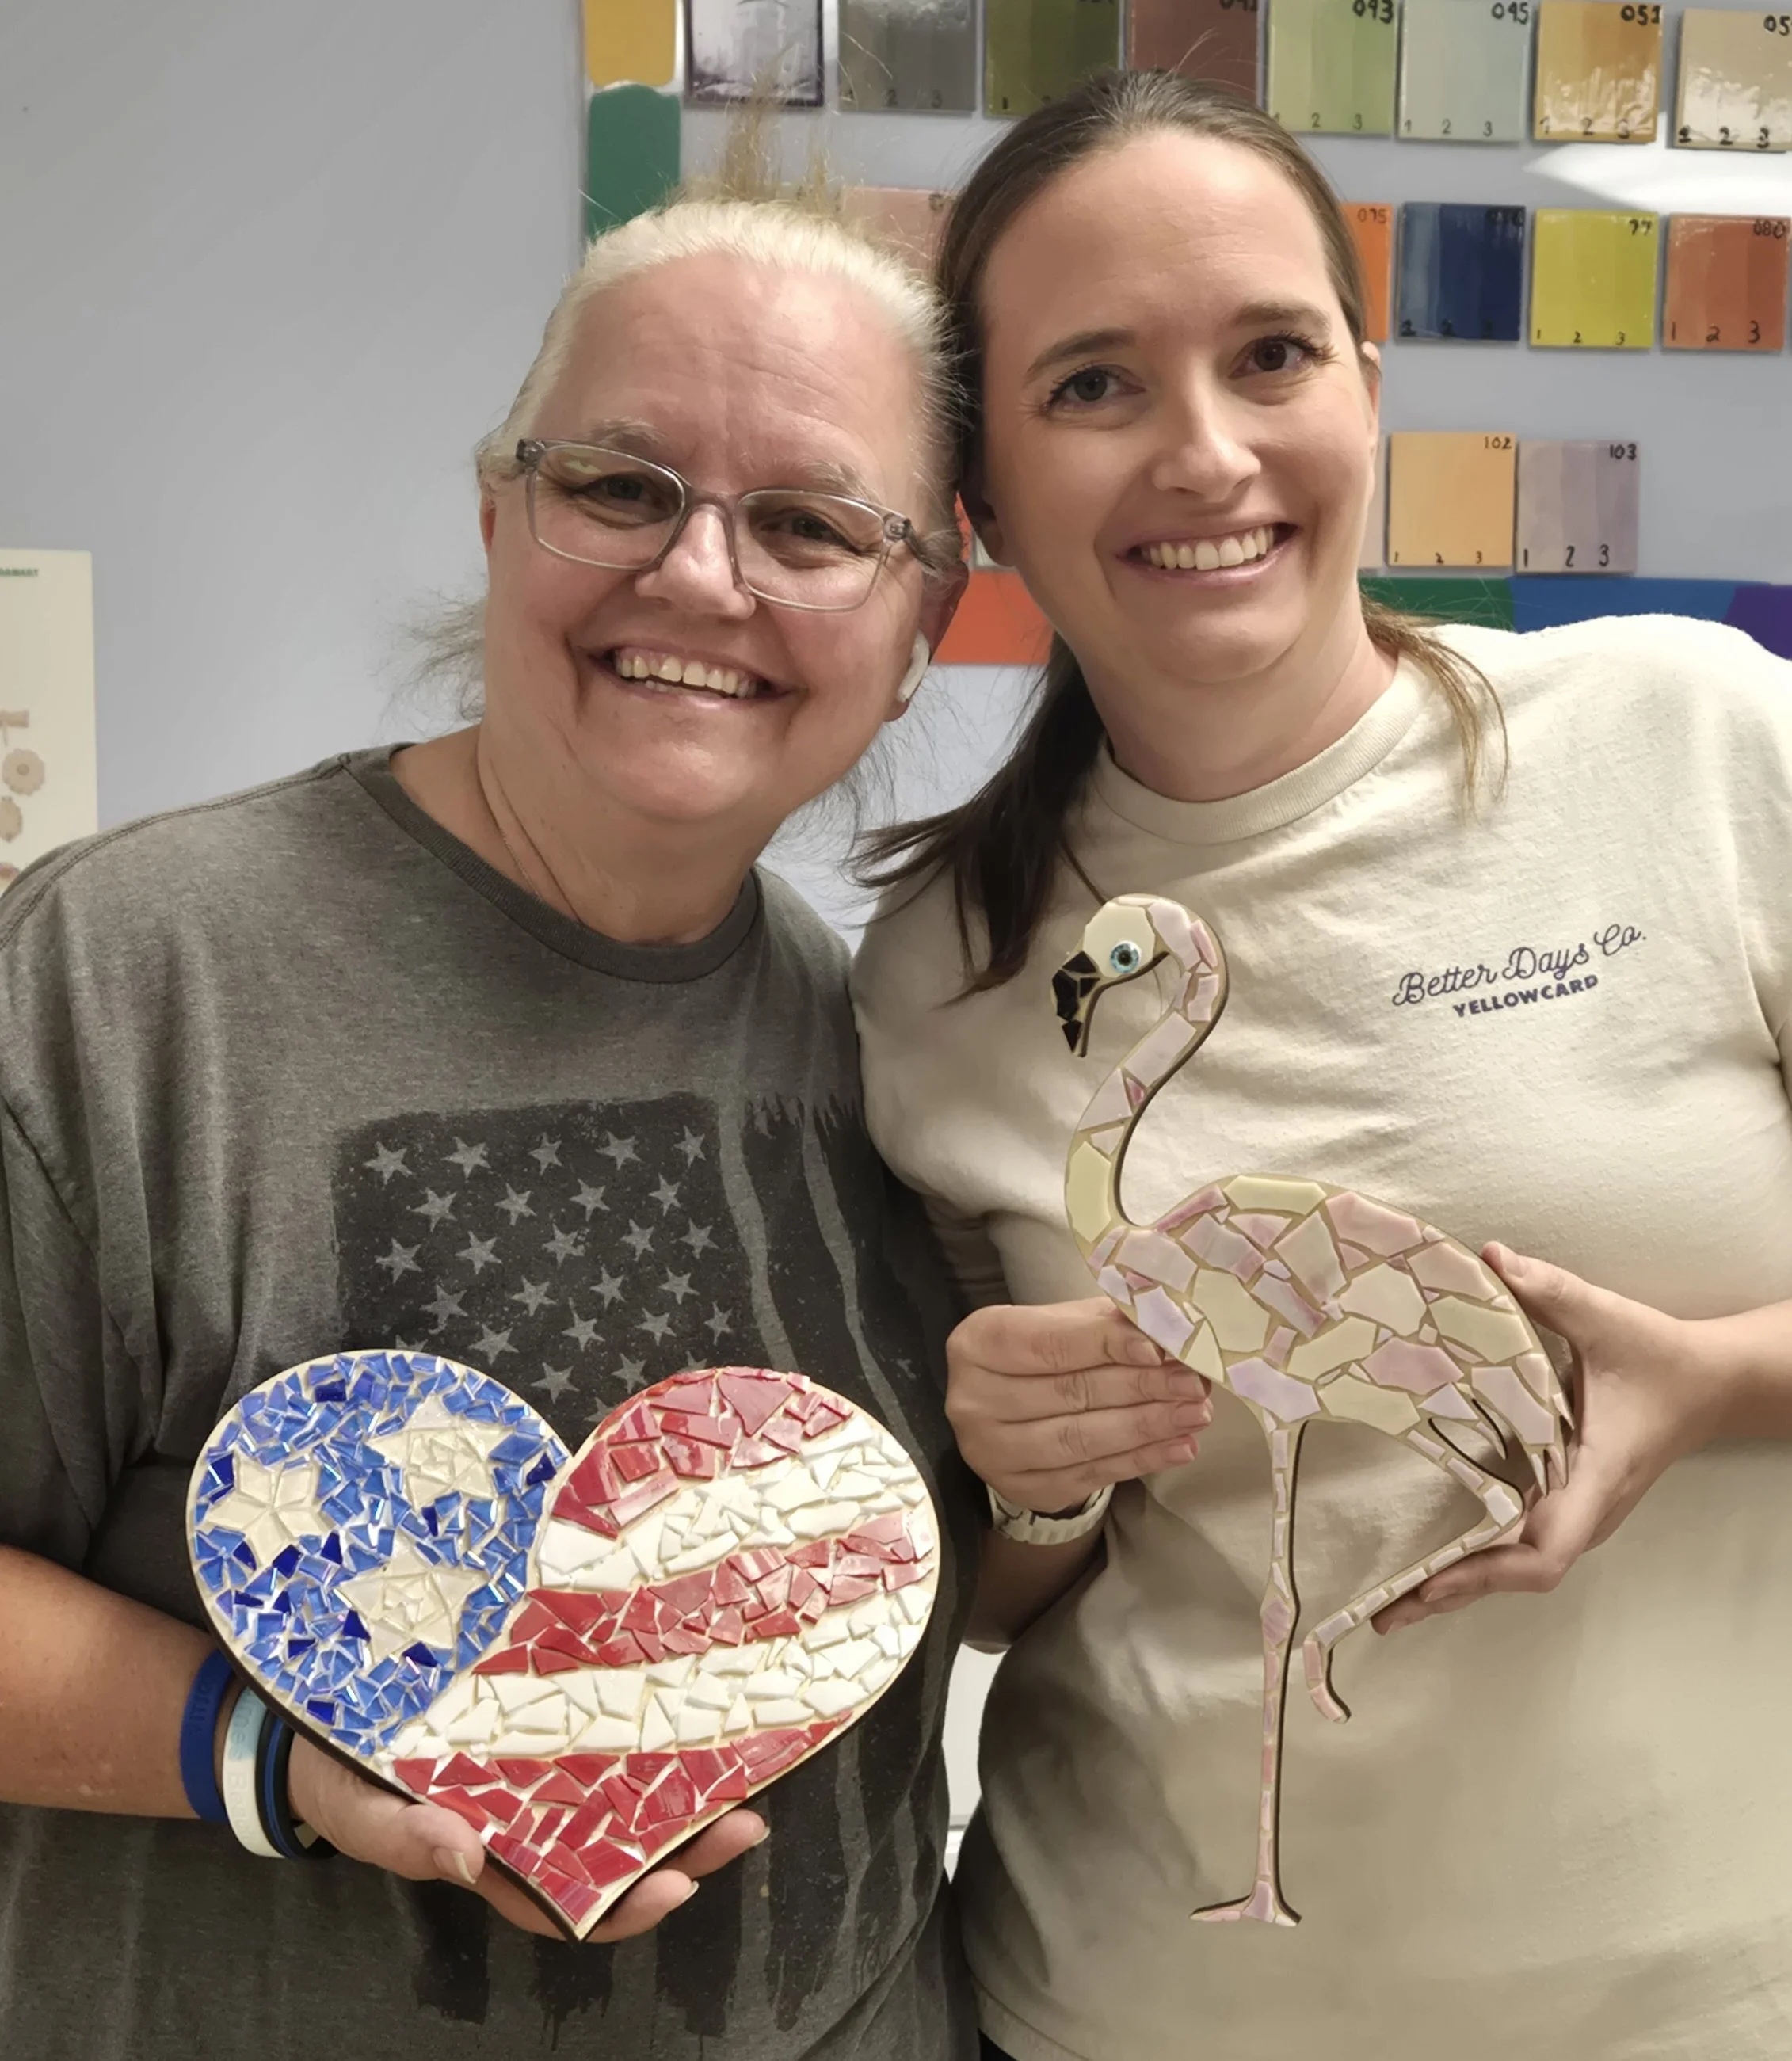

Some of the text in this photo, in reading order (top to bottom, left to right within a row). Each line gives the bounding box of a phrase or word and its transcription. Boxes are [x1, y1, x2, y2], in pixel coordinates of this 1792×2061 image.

[1620, 4, 1661, 26] 051
[1763, 14, 1792, 36] 05
[886, 89, 898, 107] 2
[931, 89, 943, 109] 3
[1311, 112, 1321, 128] 2
[1352, 113, 1363, 130] 3
[1404, 118, 1493, 137] 1 2 3
[1582, 117, 1596, 136] 2
[1719, 127, 1733, 146] 2
[1756, 127, 1770, 149] 3
[1536, 329, 1626, 346] 1 2 3
[1671, 319, 1760, 344] 1 2 3
[1484, 436, 1512, 450] 102
[1609, 443, 1638, 461] 103
[1394, 551, 1483, 564] 1 2 3
[1523, 543, 1610, 568] 1 2 3
[1391, 923, 1647, 1006] Better Days Co.
[1452, 973, 1599, 1018] YELLOWCARD
